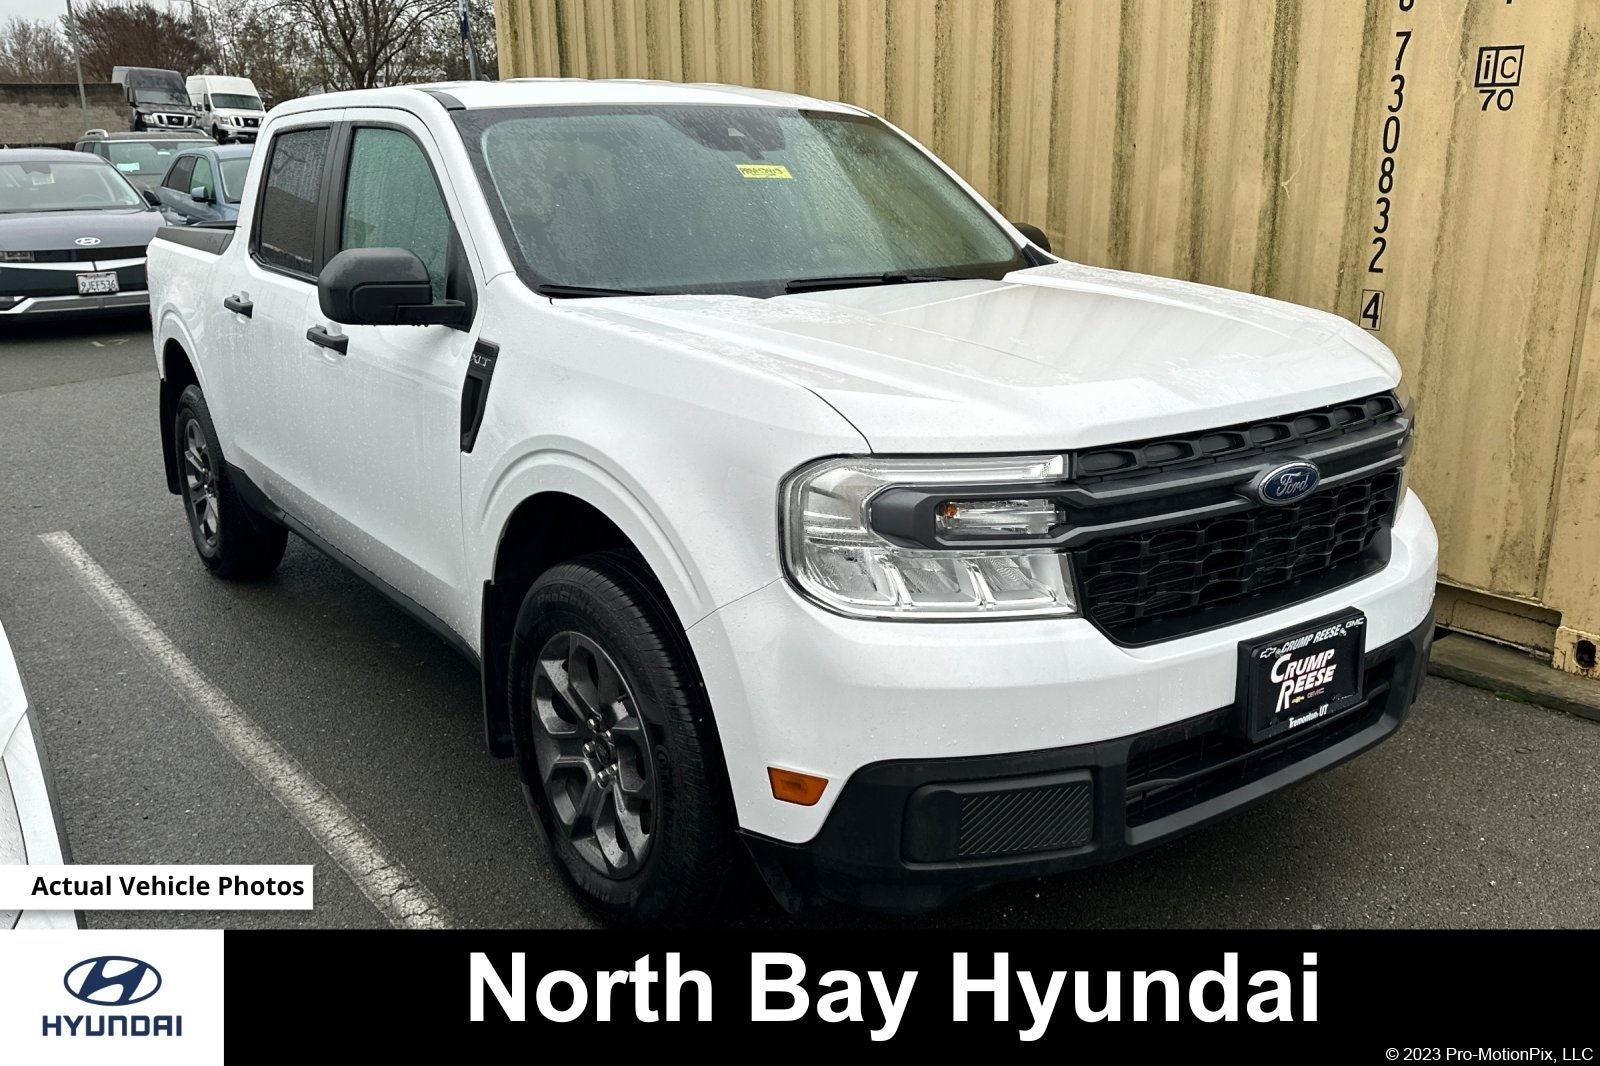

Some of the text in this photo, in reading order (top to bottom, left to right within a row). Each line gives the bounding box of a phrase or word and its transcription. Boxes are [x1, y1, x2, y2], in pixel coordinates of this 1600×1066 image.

[1478, 88, 1514, 112] 70
[1361, 292, 1381, 329] 4
[1276, 471, 1310, 497] Ford
[1281, 617, 1364, 653] CRUMP REESE GMC
[1270, 648, 1335, 684] CRUMP
[1275, 663, 1337, 713] REESE
[1319, 703, 1329, 717] UT
